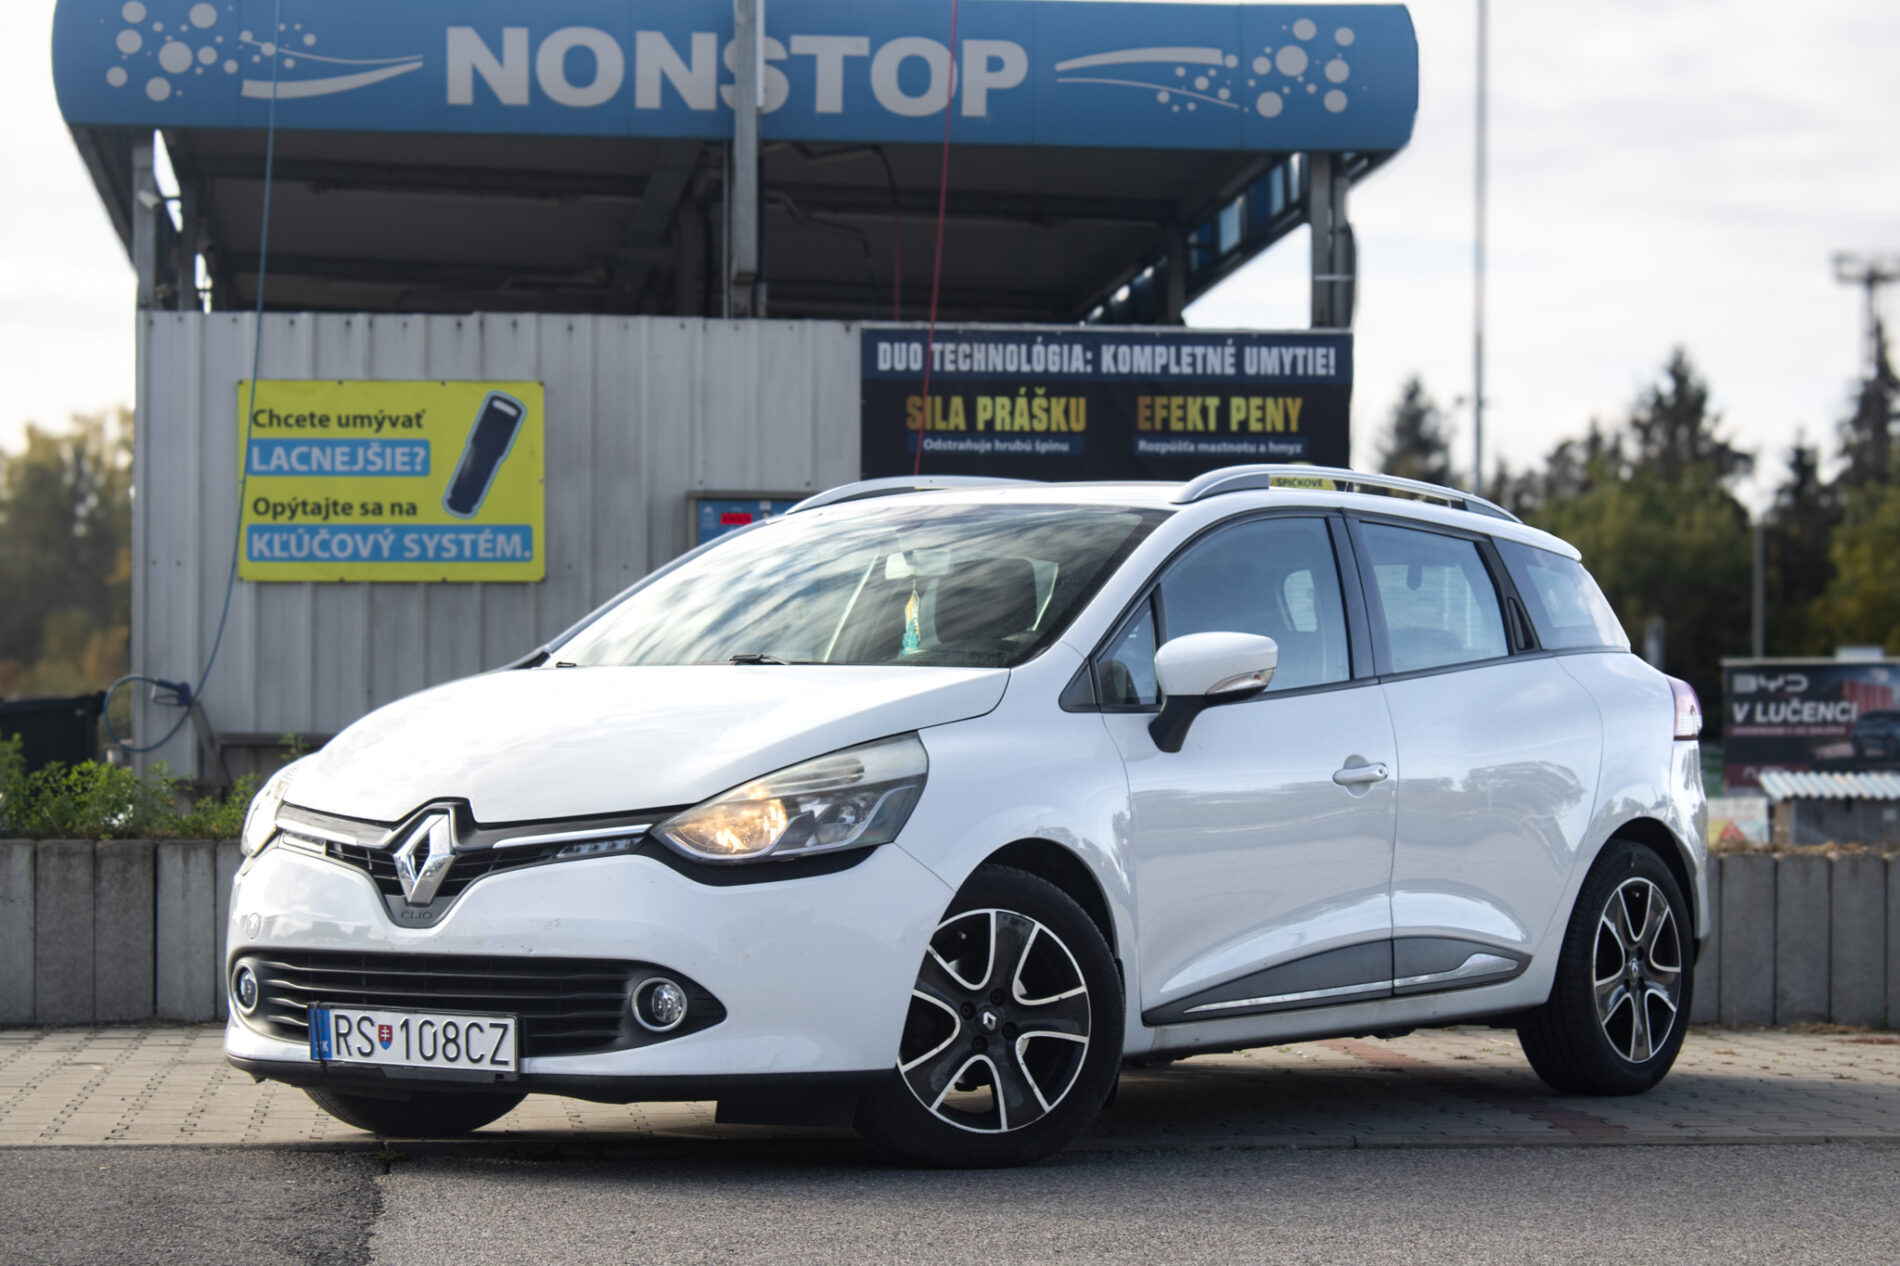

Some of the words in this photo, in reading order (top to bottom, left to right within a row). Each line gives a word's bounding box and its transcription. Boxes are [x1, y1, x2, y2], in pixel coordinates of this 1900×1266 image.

[446, 26, 1029, 117] NONSTOP
[877, 342, 922, 371] DUO
[931, 337, 1092, 373] TECHNOLÓGIA:
[1101, 339, 1236, 375] KOMPLETNÉ
[1244, 347, 1336, 376] UMYTIE!
[252, 409, 331, 429] Chcete
[337, 408, 426, 433] umývať
[905, 395, 966, 431] SILA
[976, 387, 1086, 432] PRÁŠKU
[1137, 396, 1220, 431] EFEKT
[1230, 397, 1303, 432] PENY
[252, 443, 426, 472] LACNEJŠIE?
[923, 438, 992, 454] Odstraňuje
[994, 438, 1032, 452] hrubú
[1034, 438, 1069, 454] špinu
[1198, 441, 1256, 454] mastnotu
[1258, 443, 1266, 453] a
[1269, 440, 1302, 456] hmyz
[252, 497, 354, 521] Opýtajte
[360, 500, 384, 517] sa
[390, 500, 417, 517] na
[252, 528, 395, 559] KĽÚČOVÝ
[403, 529, 532, 559] SYSTÉM.
[1733, 674, 1809, 693] BYD
[1732, 702, 1749, 723] V
[1754, 698, 1858, 723] LUČENCI
[400, 911, 432, 920] CLIO
[334, 1014, 375, 1057] RS
[399, 1018, 509, 1066] 108CZ
